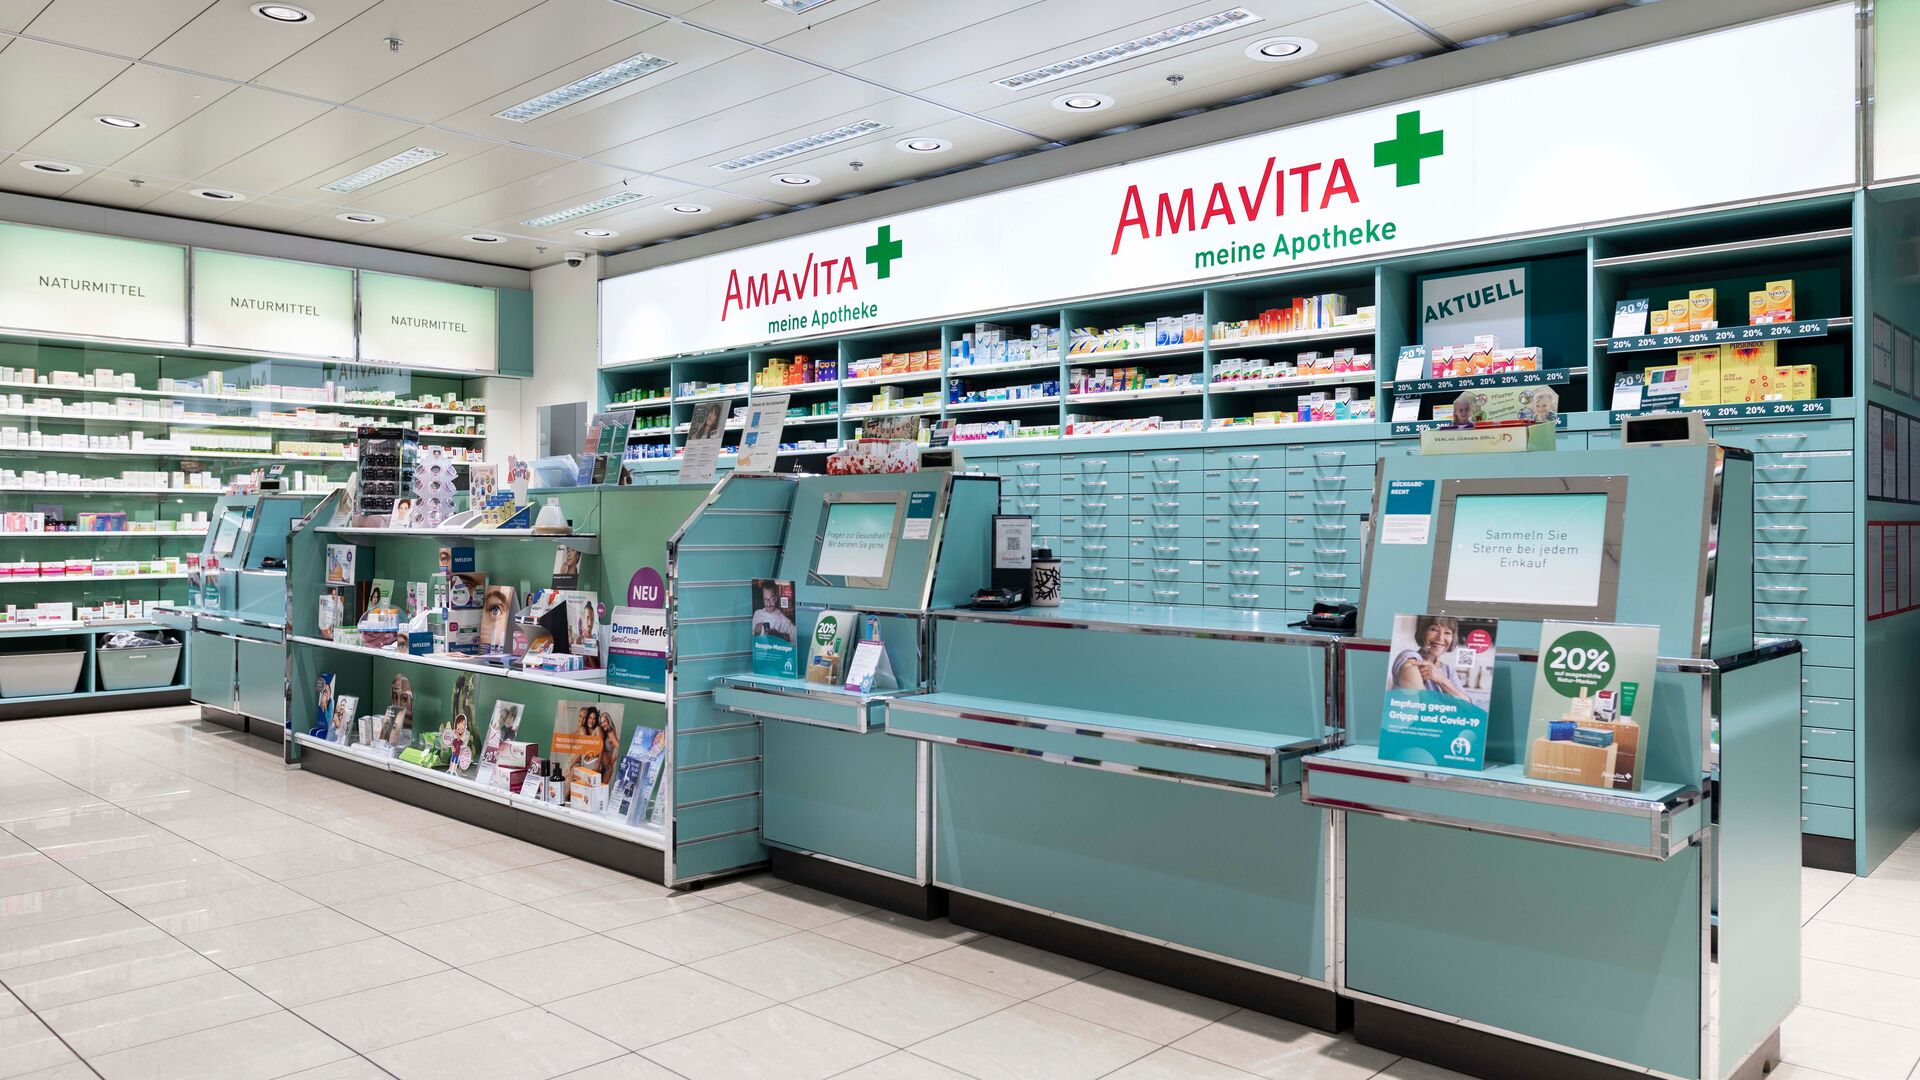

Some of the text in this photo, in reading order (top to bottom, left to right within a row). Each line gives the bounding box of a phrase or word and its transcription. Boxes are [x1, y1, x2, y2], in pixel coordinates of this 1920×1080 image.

[1195, 219, 1397, 269] meine Apotheke
[39, 275, 146, 298] NATURMITTEL
[230, 297, 320, 317] NATURMITTEL
[1424, 278, 1524, 324] AKTUELL
[1616, 303, 1635, 314] -20
[391, 315, 468, 333] NATURMITTEL
[768, 302, 878, 334] meine Apotheke
[1614, 324, 1820, 348] 20% 20% 20% 20% 20% 20% 20% 20%
[1418, 382, 1432, 390] 20%
[1438, 380, 1453, 388] 20%
[1458, 379, 1474, 387] 20%
[1480, 377, 1496, 386] 20%
[1502, 375, 1518, 384] 20%
[1524, 374, 1540, 382] 20%
[1546, 372, 1564, 381] 20%
[1614, 376, 1634, 388] -20
[1718, 407, 1738, 416] 20%
[1746, 406, 1766, 415] 20%
[1774, 404, 1794, 414] 20%
[1802, 402, 1824, 412] 20%
[1396, 425, 1410, 433] 20%
[1416, 424, 1430, 432] 20%
[828, 531, 846, 540] Fragen
[856, 532, 890, 540] Gesundheit?
[1486, 529, 1568, 541] Sammeln Sie
[1472, 544, 1579, 557] Sterne bei jedem
[1500, 558, 1548, 569] Einkauf
[632, 585, 658, 602] NEU
[818, 622, 836, 634] 20%
[1550, 646, 1610, 673] 20%
[1390, 698, 1457, 714] Impfung gegen
[1388, 710, 1480, 728] Grippe und Covid-19
